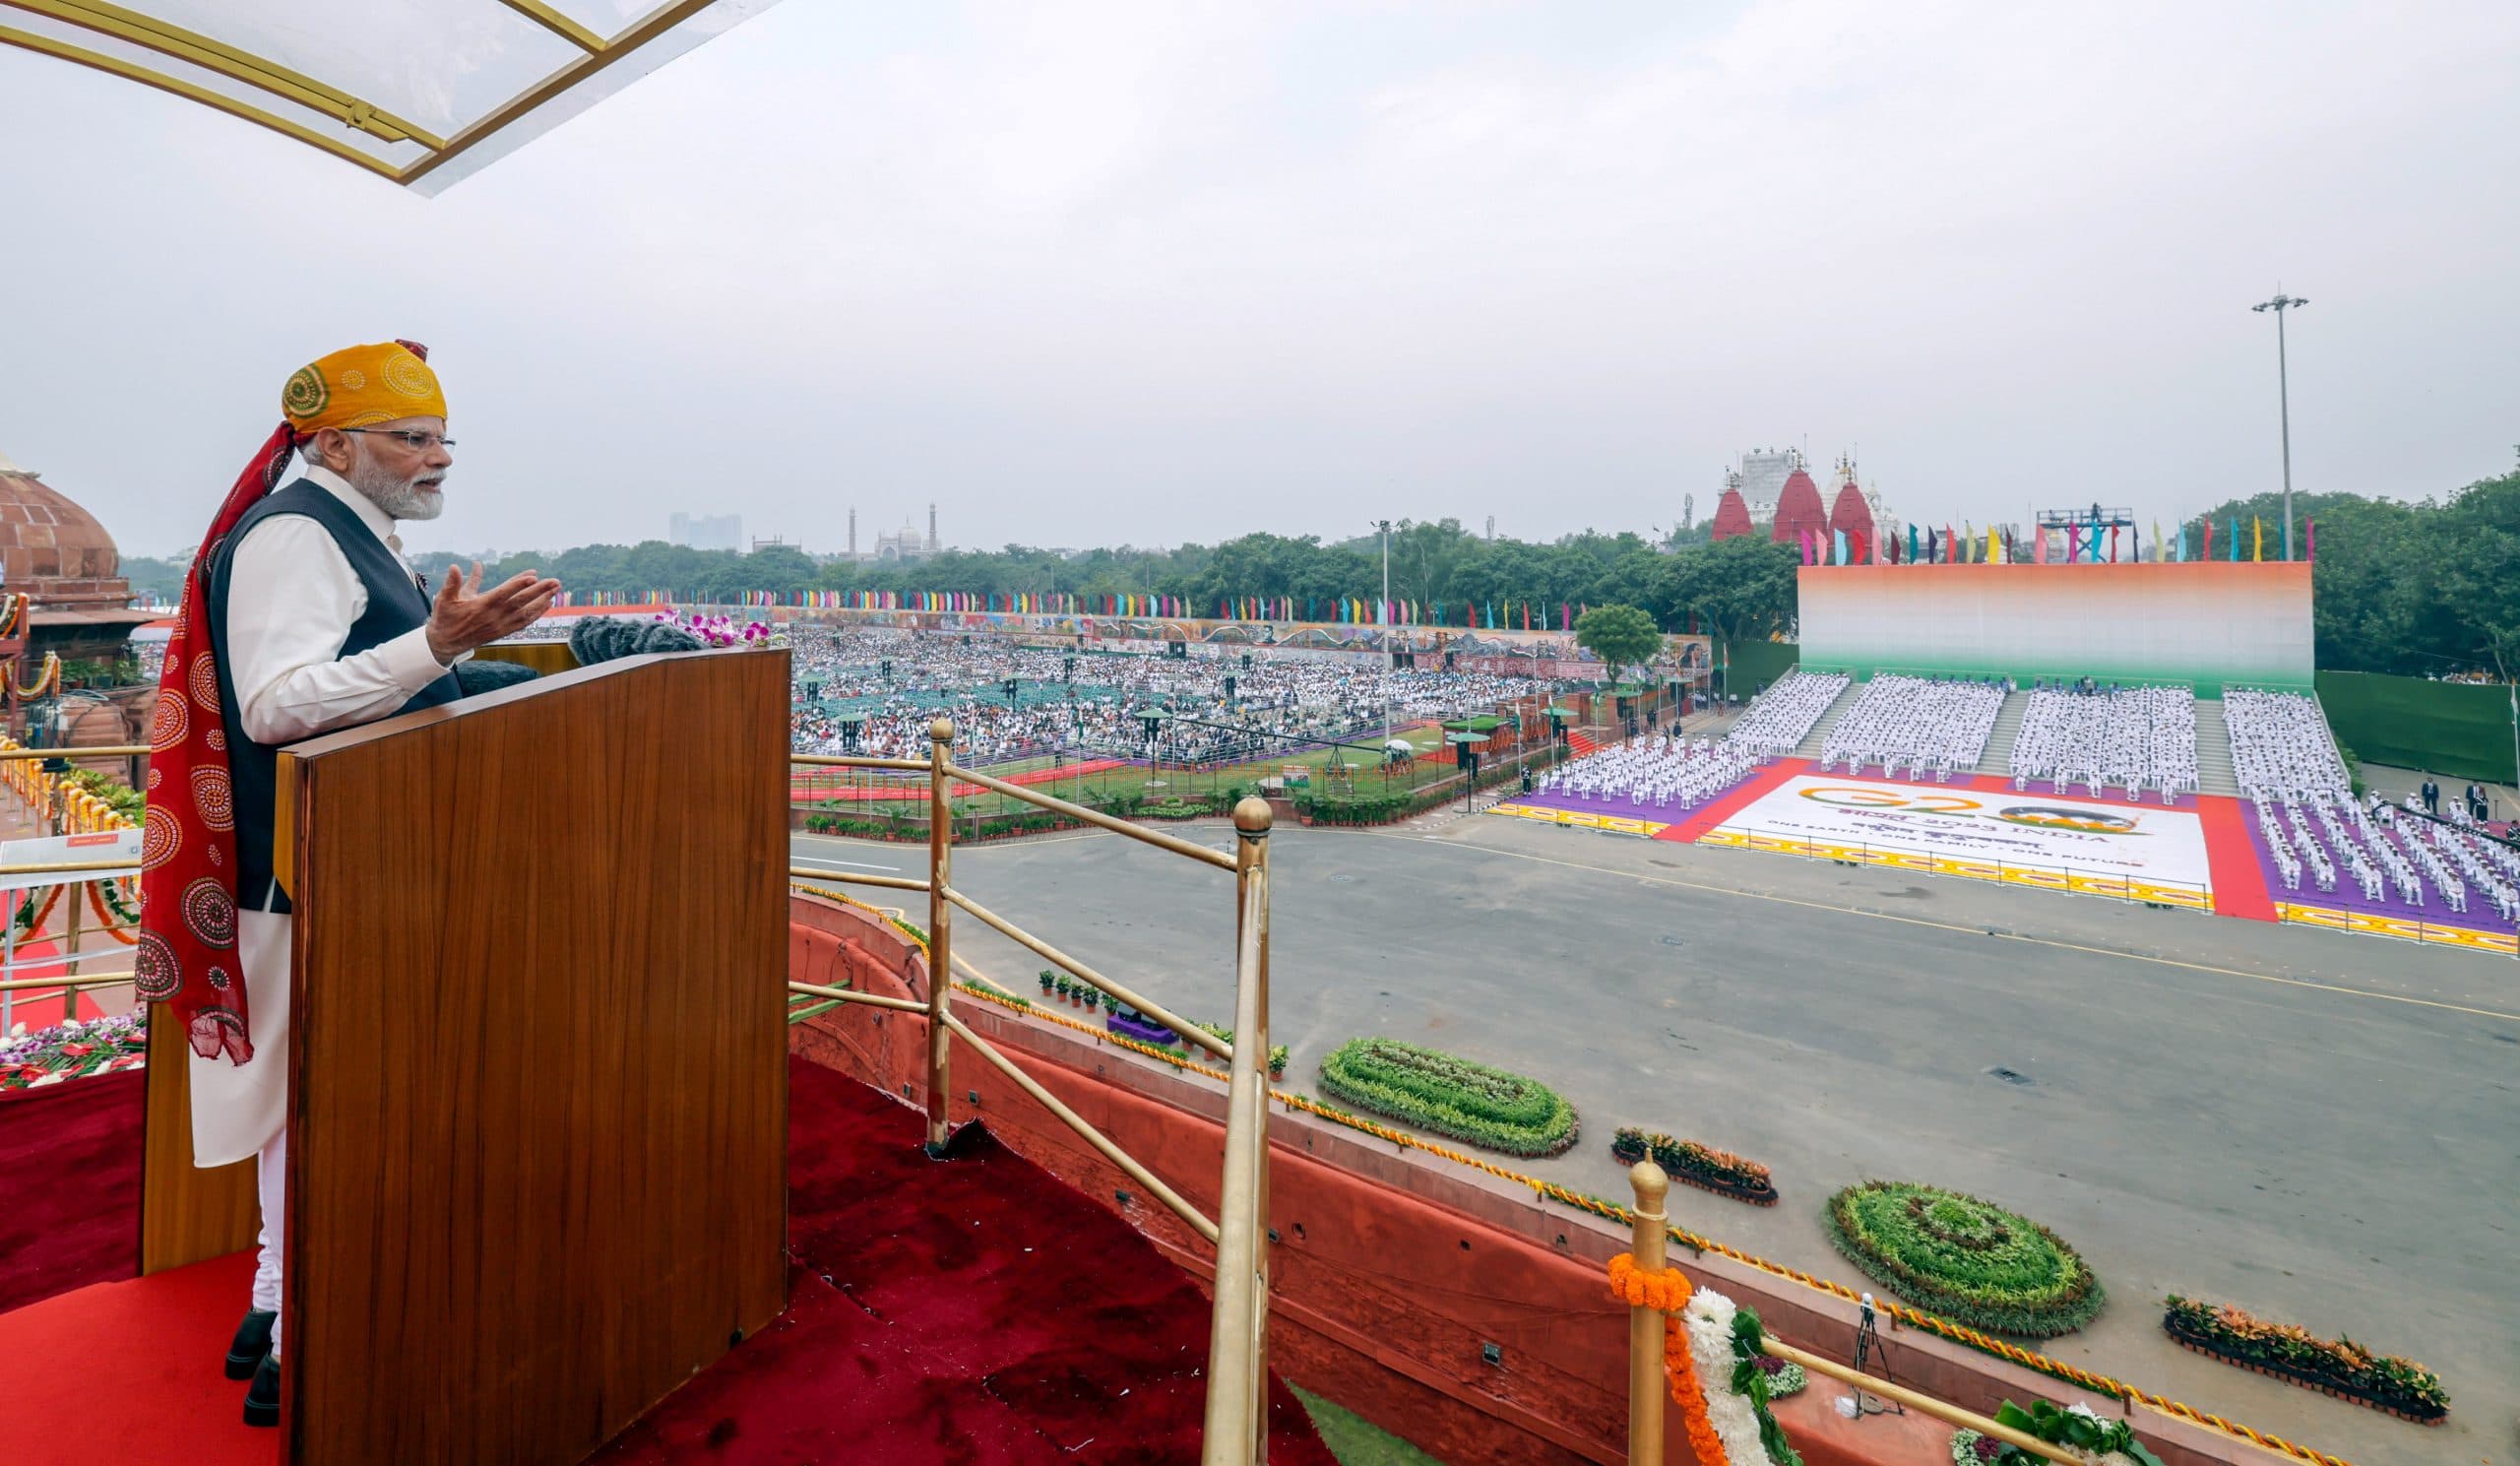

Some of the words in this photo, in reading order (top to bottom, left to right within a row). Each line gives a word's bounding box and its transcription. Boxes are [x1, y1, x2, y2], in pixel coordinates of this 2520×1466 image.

[1767, 819, 1800, 828] ONE
[1806, 825, 1859, 834] EARTH
[1923, 838, 1989, 849] FAMILY
[1925, 817, 1998, 832] 2023
[2011, 827, 2110, 843] INDIA
